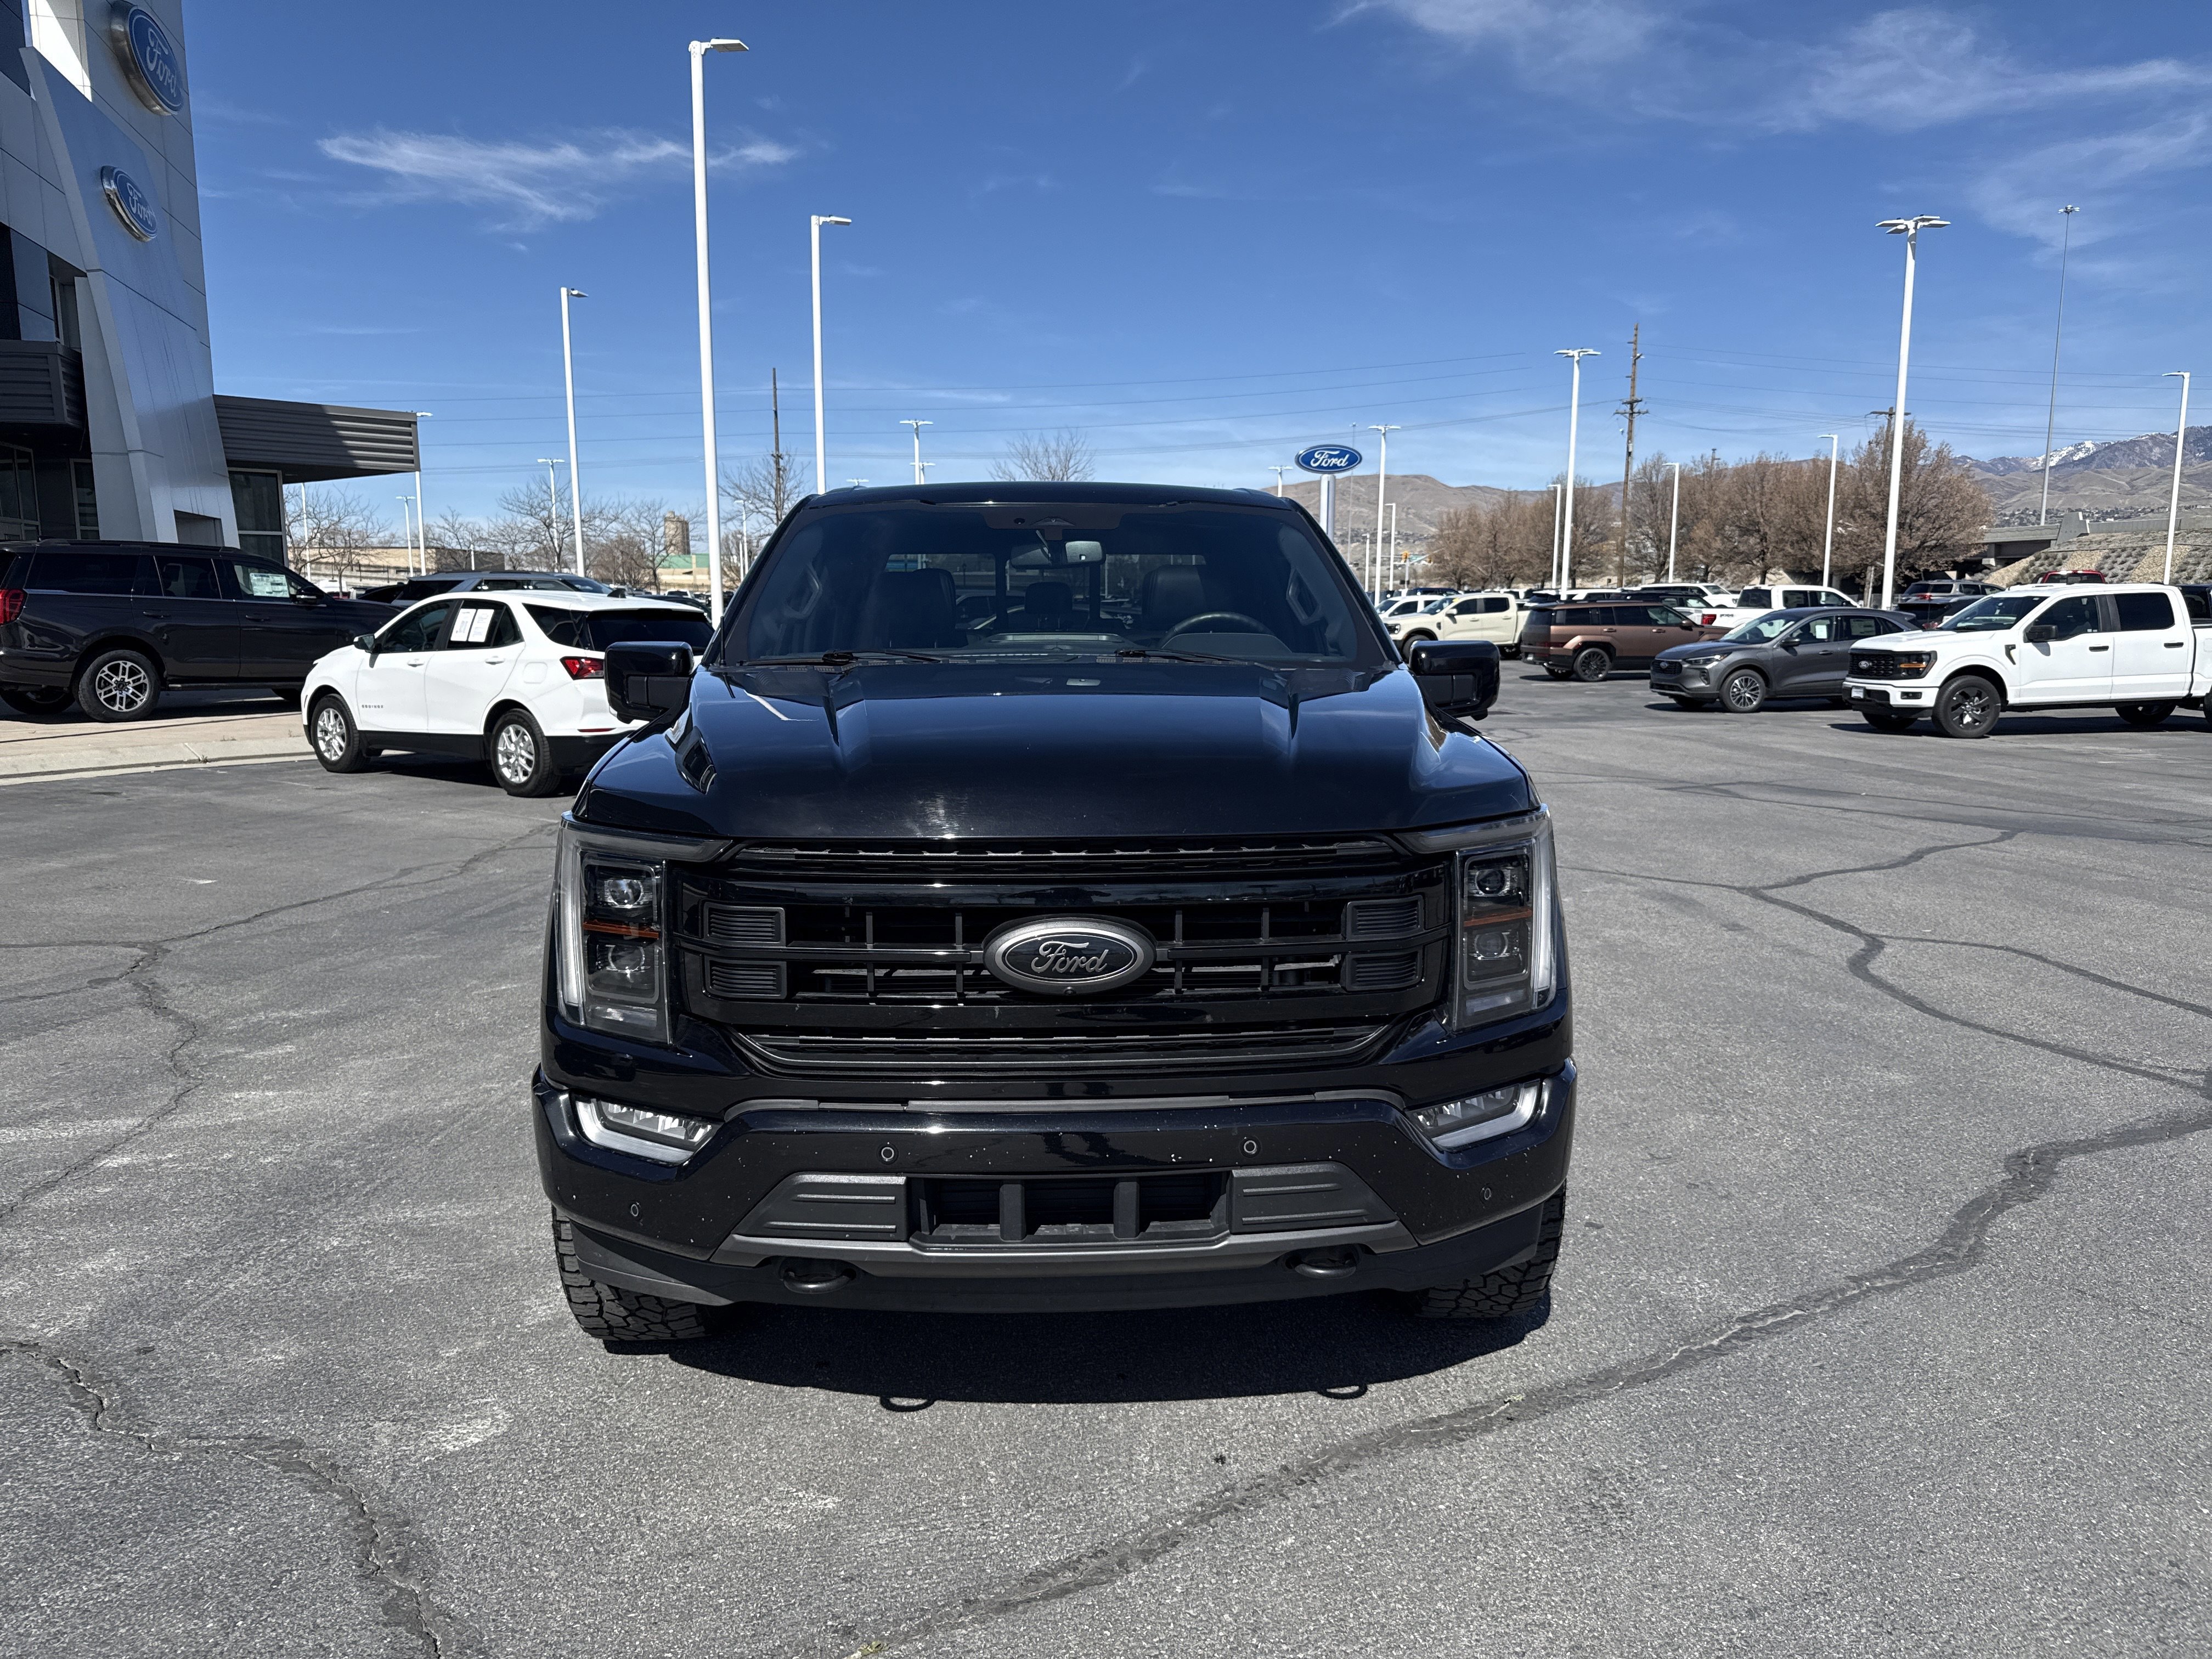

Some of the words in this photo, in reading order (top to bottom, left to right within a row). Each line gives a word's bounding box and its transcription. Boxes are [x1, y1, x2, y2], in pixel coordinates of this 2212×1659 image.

[146, 27, 177, 97] Ford
[126, 183, 154, 227] Ford
[1310, 450, 1350, 467] Ford
[1031, 941, 1109, 973] Ford
